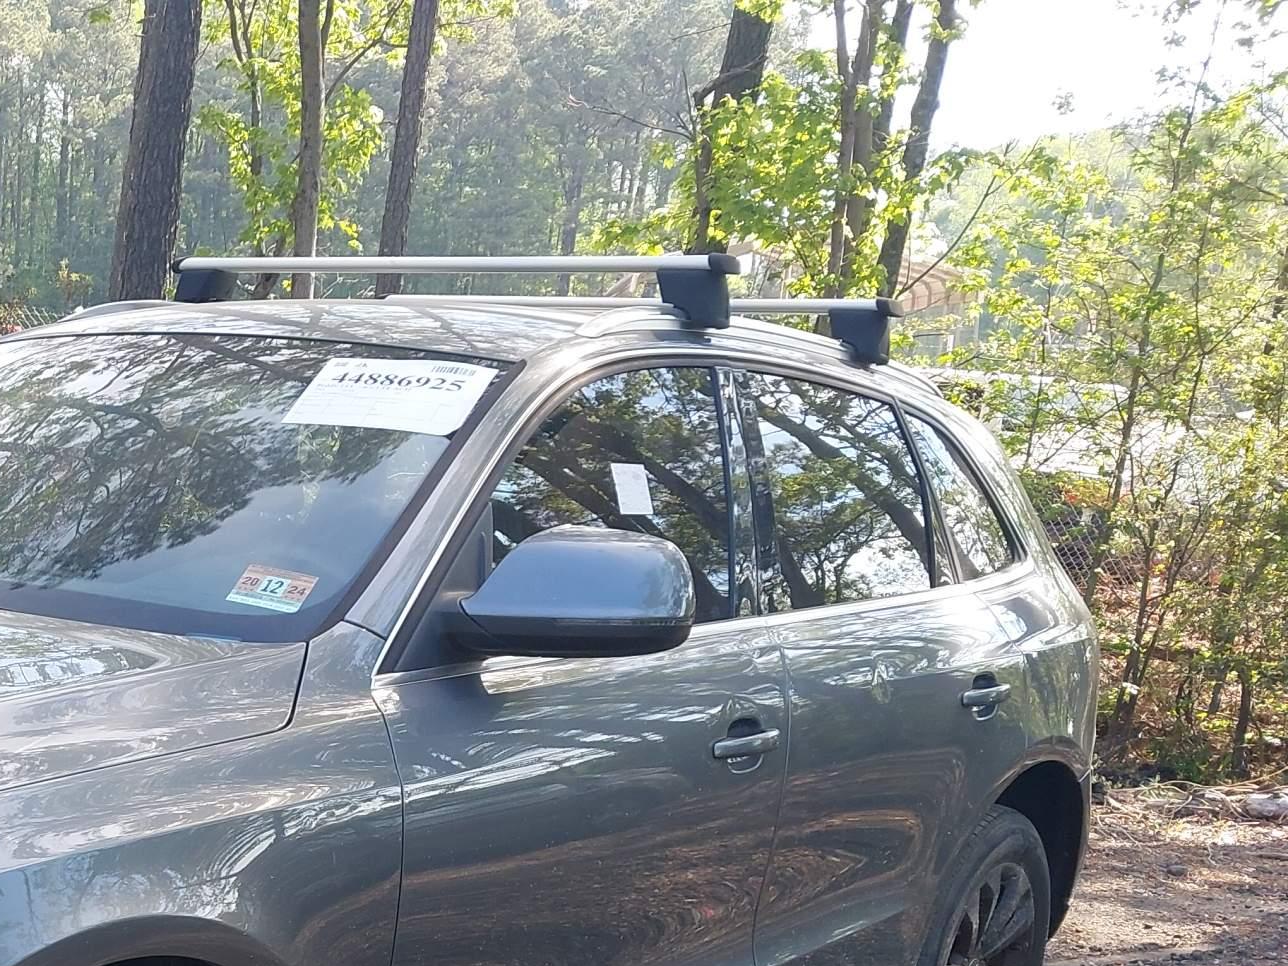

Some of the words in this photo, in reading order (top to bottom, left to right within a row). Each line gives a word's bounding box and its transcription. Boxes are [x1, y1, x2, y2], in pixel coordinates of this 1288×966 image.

[331, 372, 467, 392] 44886925
[241, 576, 260, 586] 20
[260, 579, 285, 594] 12
[287, 585, 307, 596] 24
